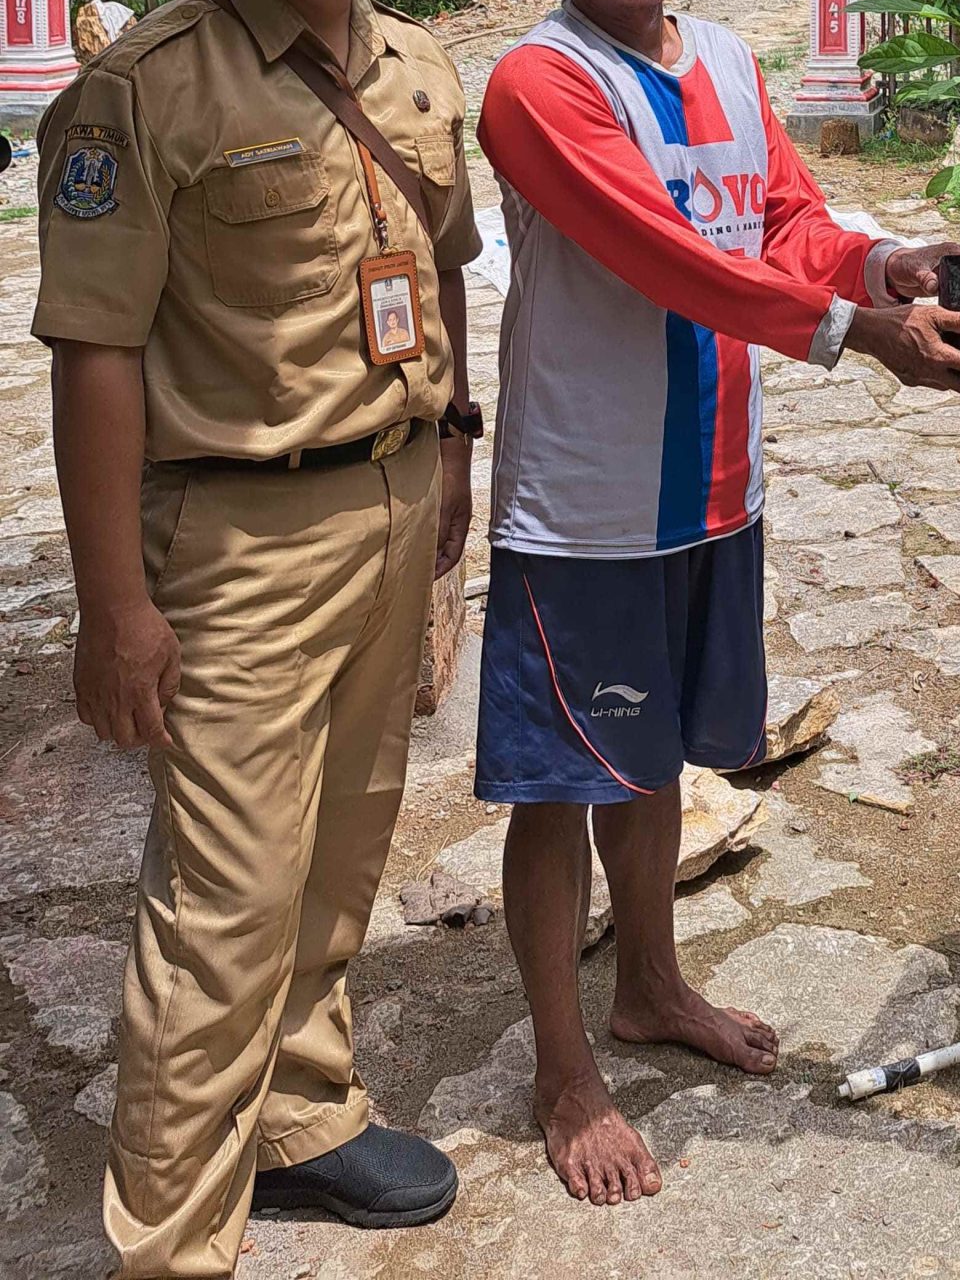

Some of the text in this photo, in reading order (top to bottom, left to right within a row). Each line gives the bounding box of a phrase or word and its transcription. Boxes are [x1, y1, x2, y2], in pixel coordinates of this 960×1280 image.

[68, 126, 129, 147] JAWA TIMUR
[590, 706, 641, 718] LI-NING
